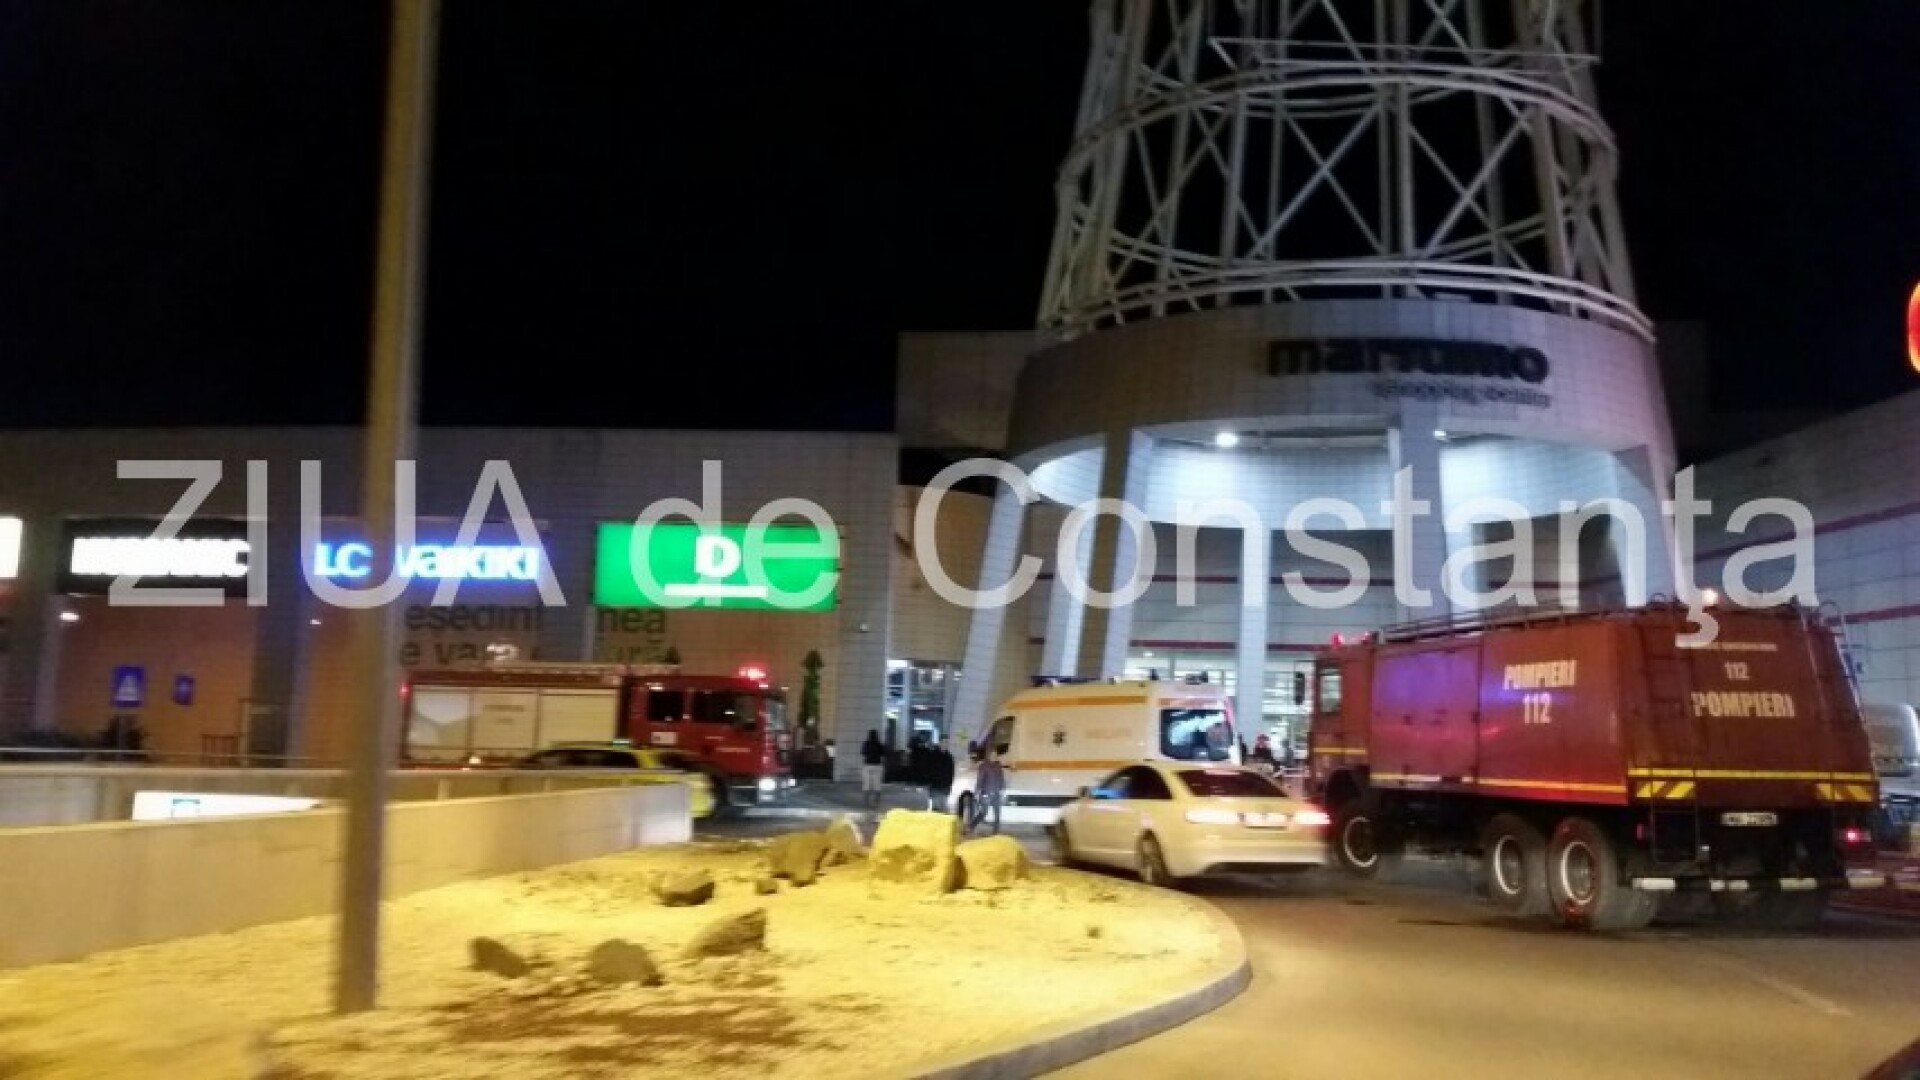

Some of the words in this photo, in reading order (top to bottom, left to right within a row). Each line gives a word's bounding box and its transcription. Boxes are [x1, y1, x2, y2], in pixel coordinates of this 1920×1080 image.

[314, 543, 373, 577] LC
[1503, 660, 1577, 690] POMPIERI
[1724, 661, 1750, 680] 112
[1522, 692, 1552, 724] 112
[1690, 692, 1796, 717] POMPIERI
